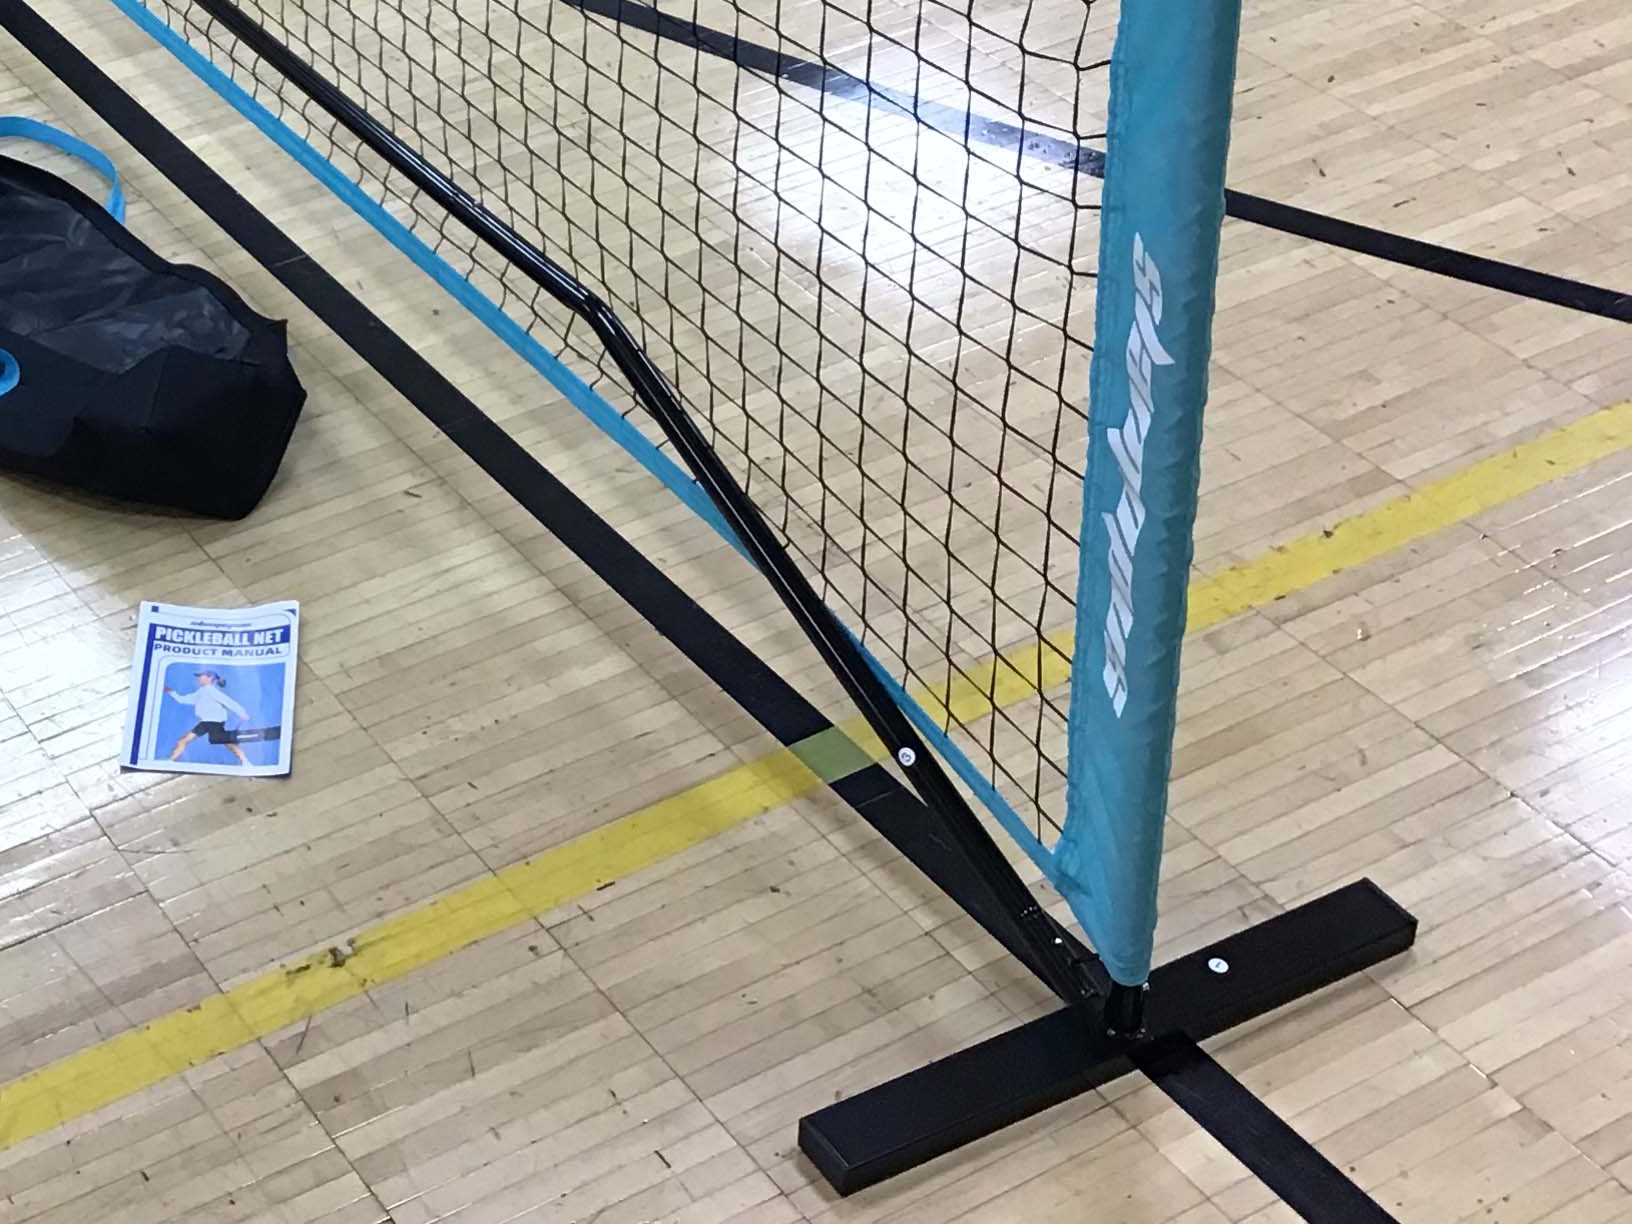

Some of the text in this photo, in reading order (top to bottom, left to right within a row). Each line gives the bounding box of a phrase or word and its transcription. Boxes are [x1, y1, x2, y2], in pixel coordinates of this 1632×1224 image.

[155, 626, 284, 646] PICKLEBALL NET
[154, 643, 283, 657] PRODUCT MANUAL
